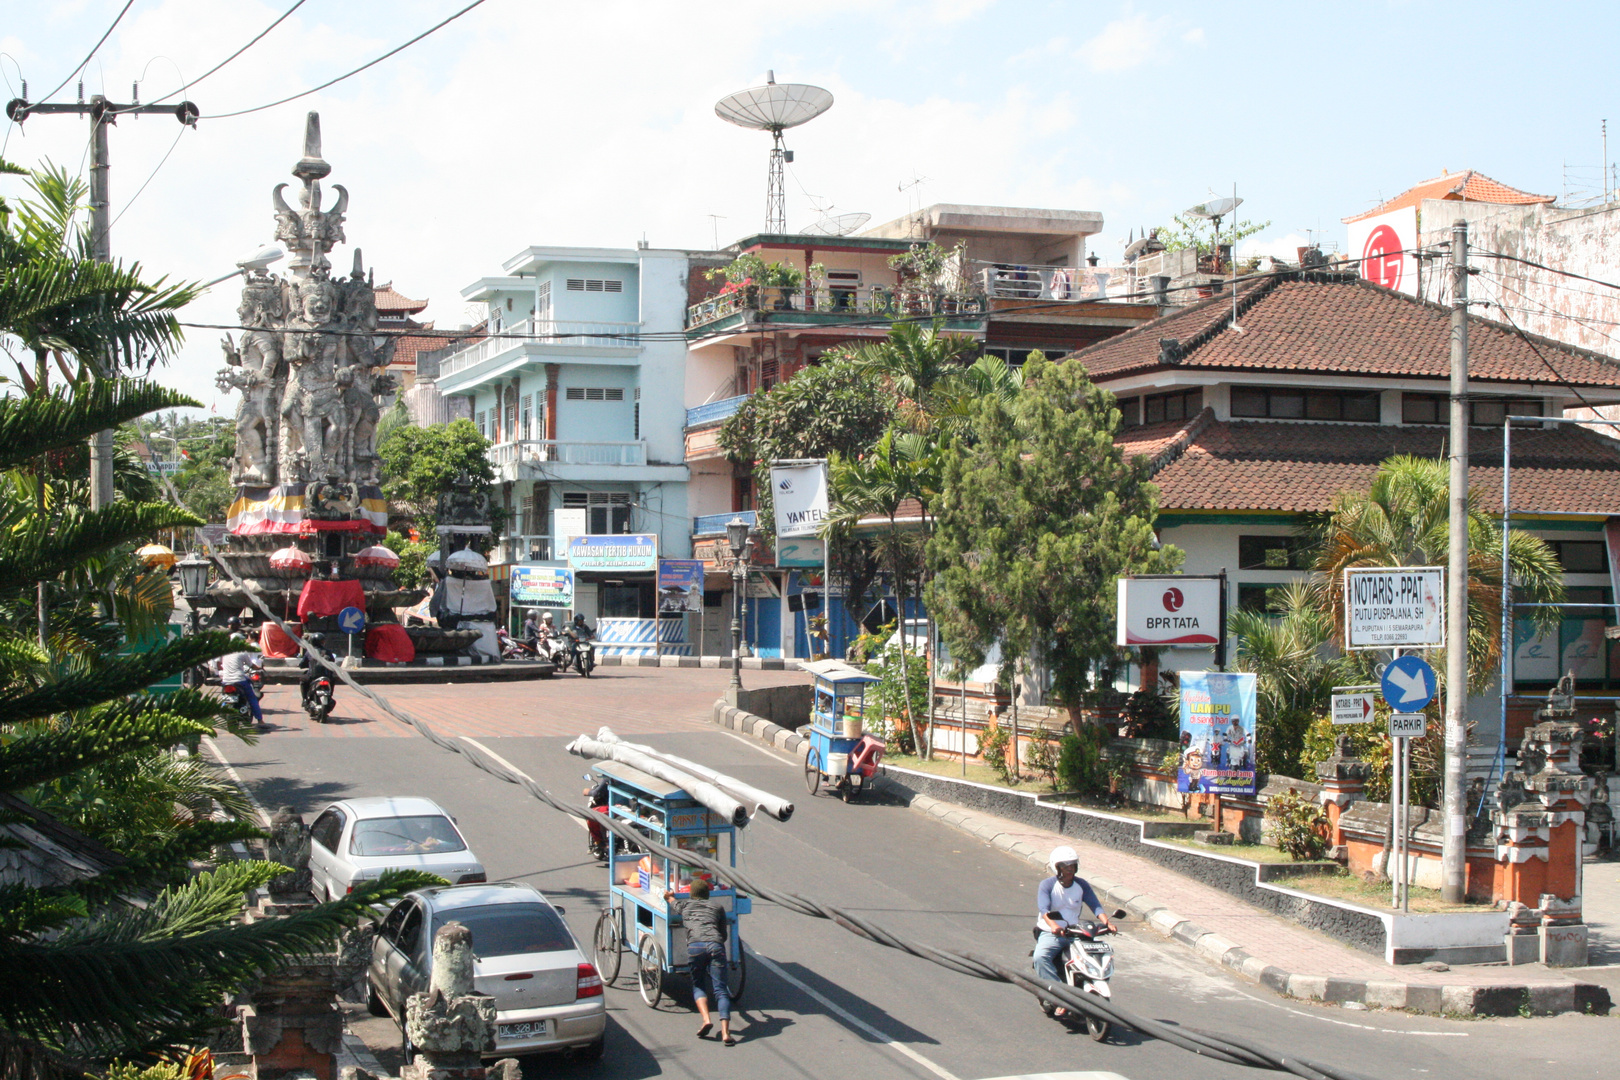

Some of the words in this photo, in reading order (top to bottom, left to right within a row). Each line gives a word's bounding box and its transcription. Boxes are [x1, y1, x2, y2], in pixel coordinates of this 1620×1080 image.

[787, 509, 826, 523] YANTEL
[573, 545, 604, 557] KAWASAN
[605, 545, 627, 557] TERTIB
[628, 545, 652, 557] HUKUM
[1354, 576, 1393, 605] NOTARIS
[1401, 576, 1423, 604] PPAT
[1355, 607, 1372, 620] PUTU
[1373, 607, 1413, 620] PUSPAJANA,
[1414, 607, 1424, 619] SH
[1146, 617, 1170, 629] BPR
[1172, 617, 1199, 629] TATA
[1362, 624, 1383, 632] PUPUTAN
[1190, 703, 1231, 715] LAMPU
[1190, 715, 1196, 724] di
[1197, 716, 1215, 727] siang
[1216, 715, 1229, 724] hari
[1393, 719, 1422, 731] PARKIR
[1238, 770, 1254, 778] lamp
[515, 1023, 531, 1034] 328
